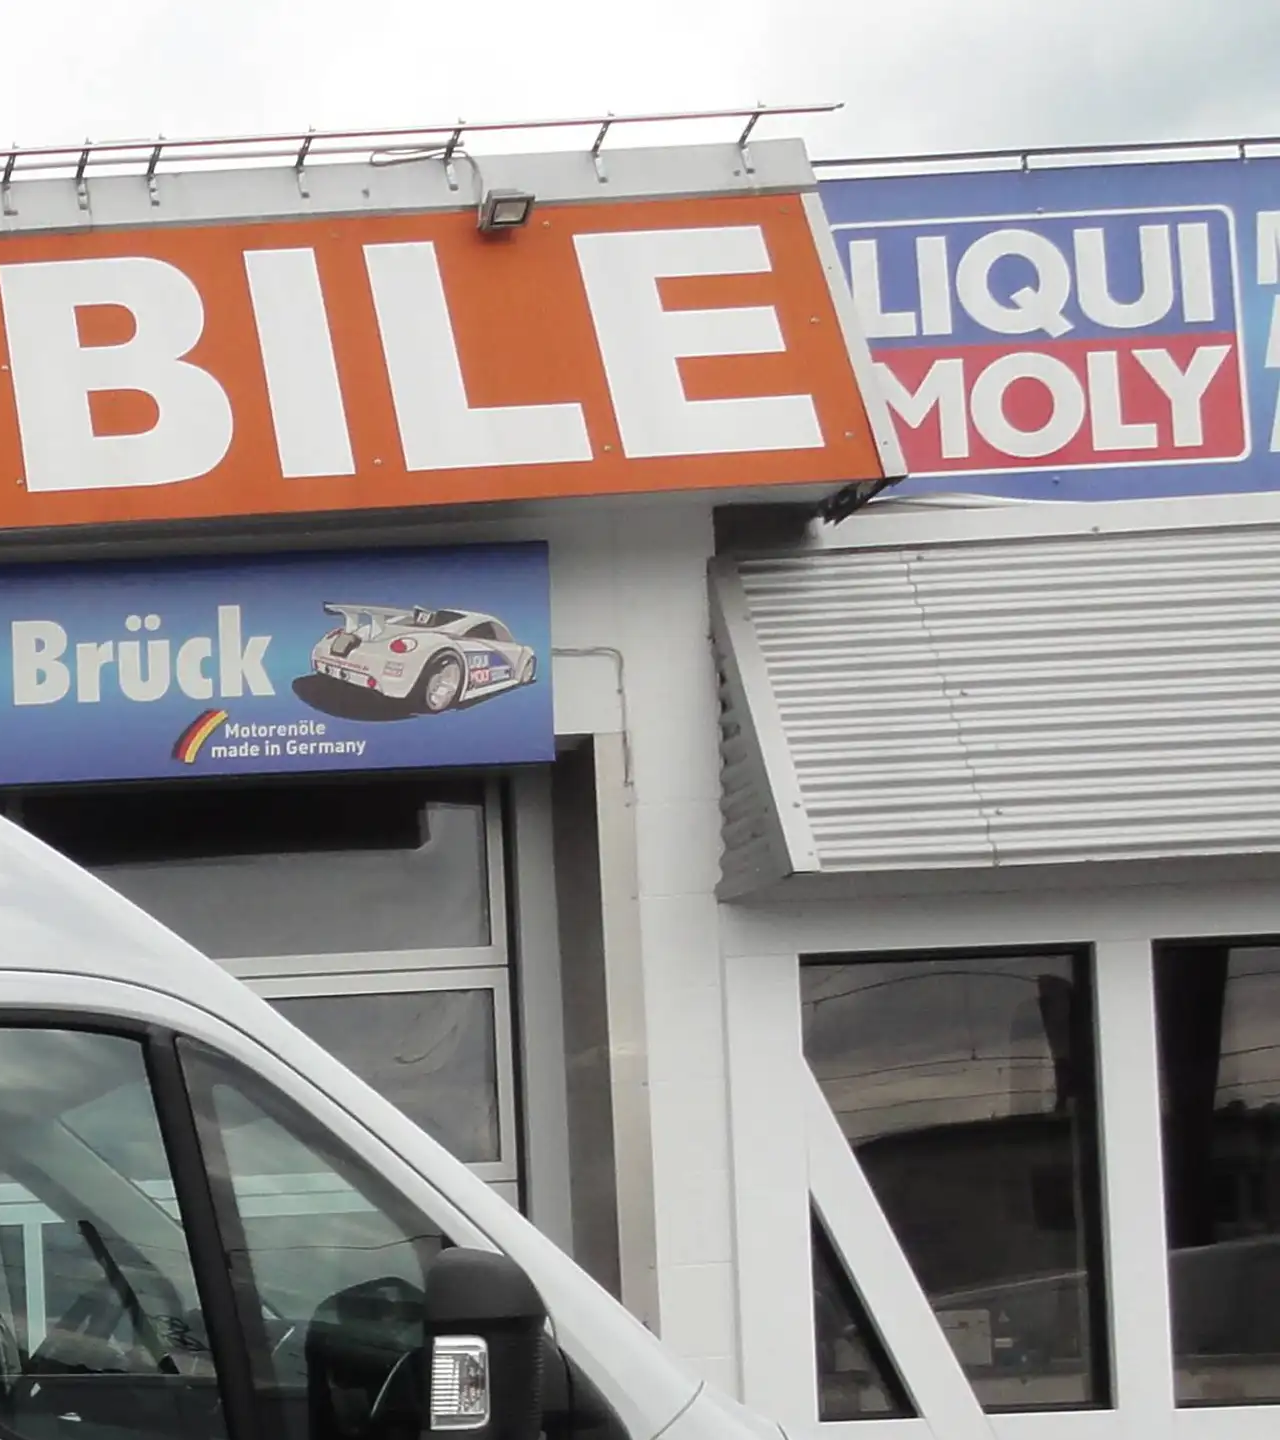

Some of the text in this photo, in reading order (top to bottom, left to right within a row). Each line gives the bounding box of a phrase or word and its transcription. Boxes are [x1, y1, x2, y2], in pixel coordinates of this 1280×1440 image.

[848, 221, 1215, 338] LIQUI
[872, 344, 1233, 459] MOLY
[11, 605, 275, 706] Brück
[211, 739, 366, 758] made in Germany
[225, 720, 326, 739] Motorenöle
